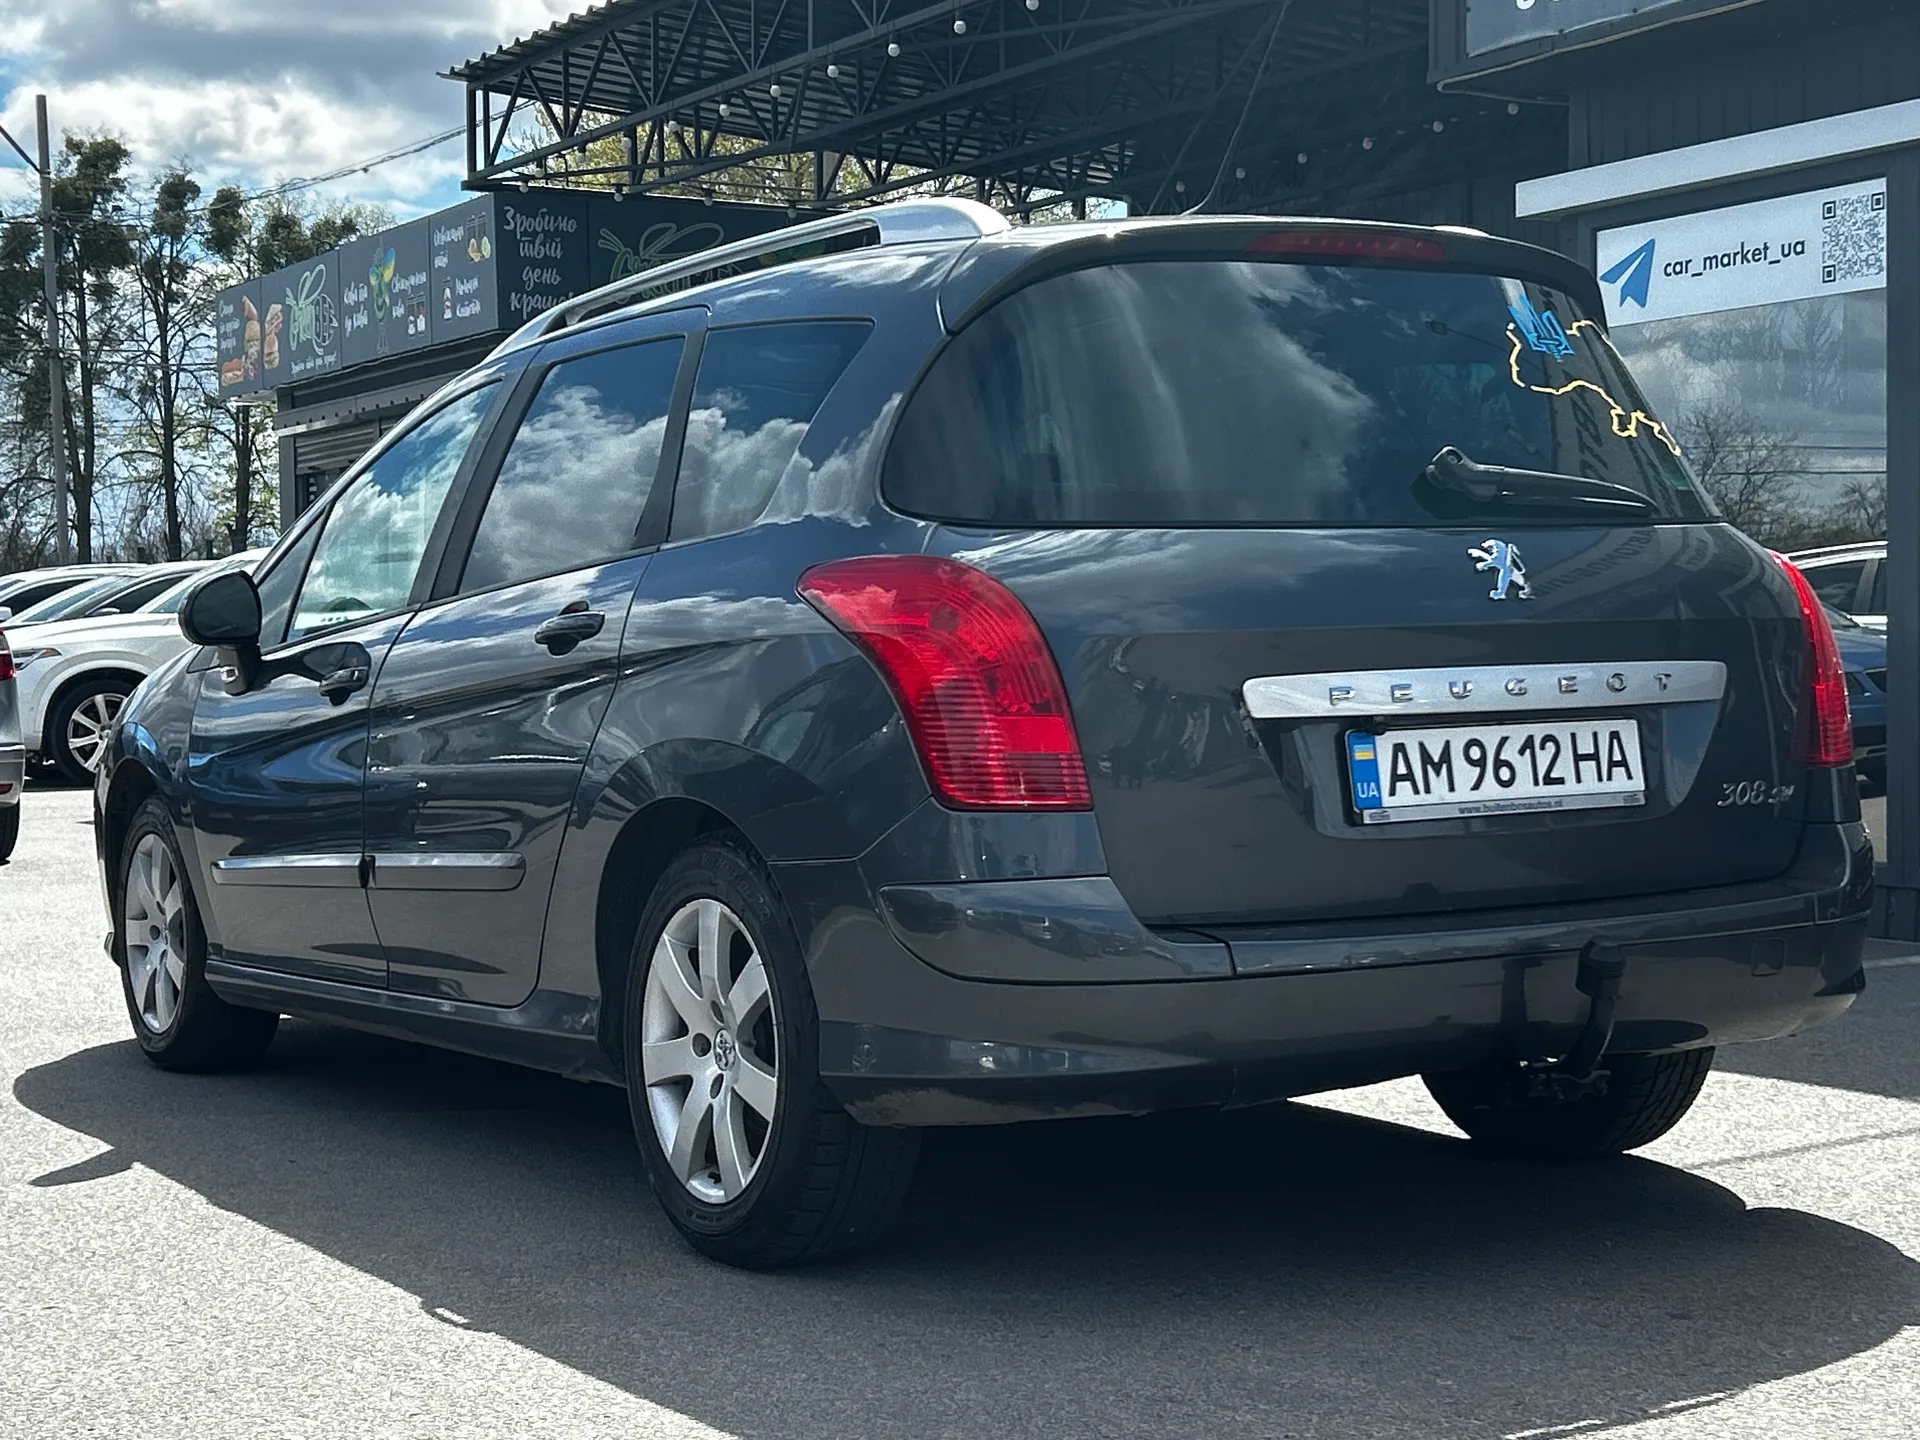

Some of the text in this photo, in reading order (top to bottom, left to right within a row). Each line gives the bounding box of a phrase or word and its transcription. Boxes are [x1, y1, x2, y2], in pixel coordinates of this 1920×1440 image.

[503, 205, 578, 240] Зробимо
[519, 233, 564, 259] твій
[1663, 239, 1806, 278] car_market_ua
[522, 266, 562, 291] день
[1328, 673, 1672, 707] PEUGEOT
[1356, 781, 1379, 798] UA
[1716, 780, 1766, 806] 308
